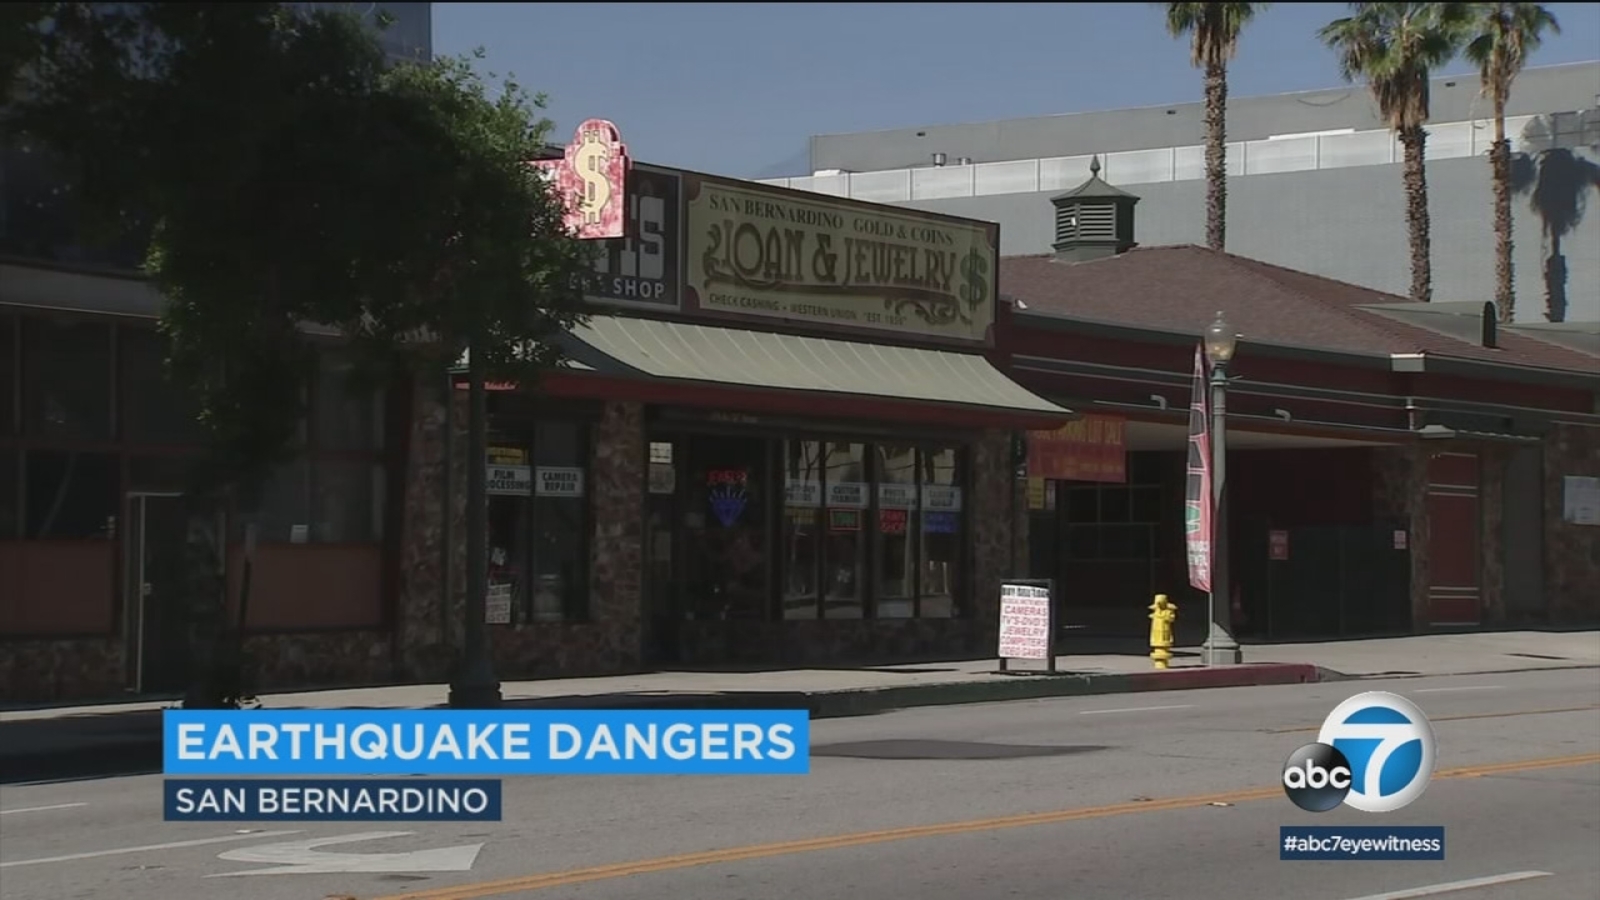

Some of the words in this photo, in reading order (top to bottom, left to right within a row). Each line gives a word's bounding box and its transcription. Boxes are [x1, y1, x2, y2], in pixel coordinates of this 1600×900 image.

[709, 194, 741, 212] SAN
[745, 200, 844, 230] BERNARDINO
[853, 217, 894, 237] GOLD
[896, 224, 907, 239] &
[910, 227, 954, 245] COINS
[720, 219, 804, 284] LOAN
[813, 232, 837, 282] &
[841, 237, 957, 291] JEWELRY
[613, 278, 665, 299] SHOP
[709, 293, 739, 307] CHECK
[740, 295, 779, 311] CASHING
[789, 303, 829, 318] WESTERN
[494, 469, 515, 479] FILM
[542, 471, 578, 481] CAMERA
[483, 479, 531, 490] OCESSING
[545, 481, 575, 491] REPAIR
[1004, 605, 1047, 616] CAMERAS
[1003, 626, 1046, 637] JEWELRY
[1000, 636, 1046, 647] COMPUTERS
